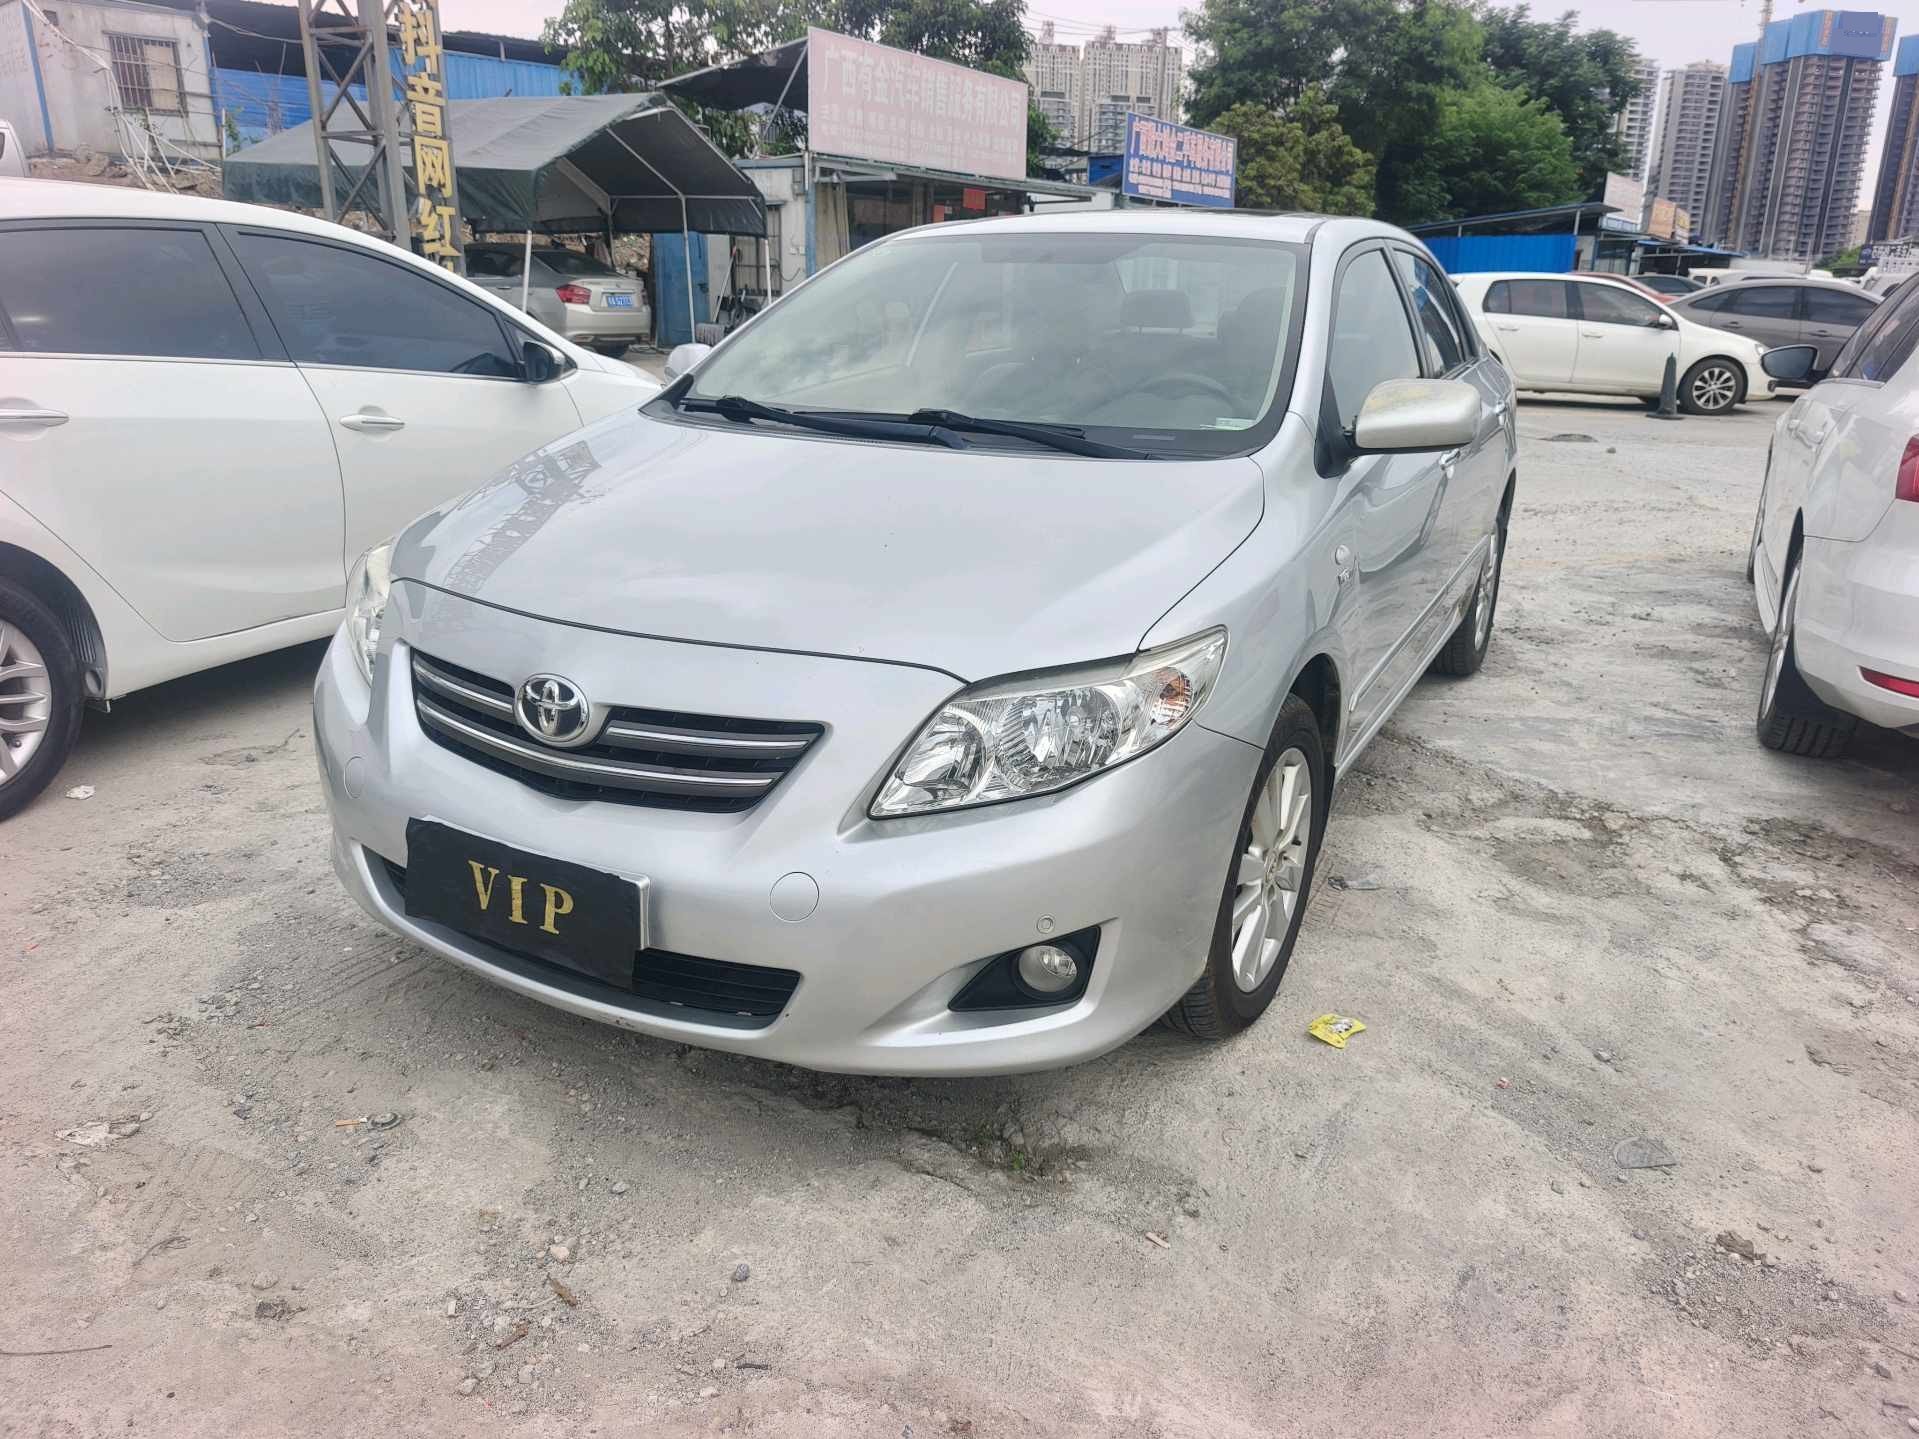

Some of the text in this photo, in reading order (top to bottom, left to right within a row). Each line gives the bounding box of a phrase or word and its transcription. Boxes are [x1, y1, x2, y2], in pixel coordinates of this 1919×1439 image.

[396, 1, 463, 272] 抖音网红
[468, 860, 574, 935] VIP
